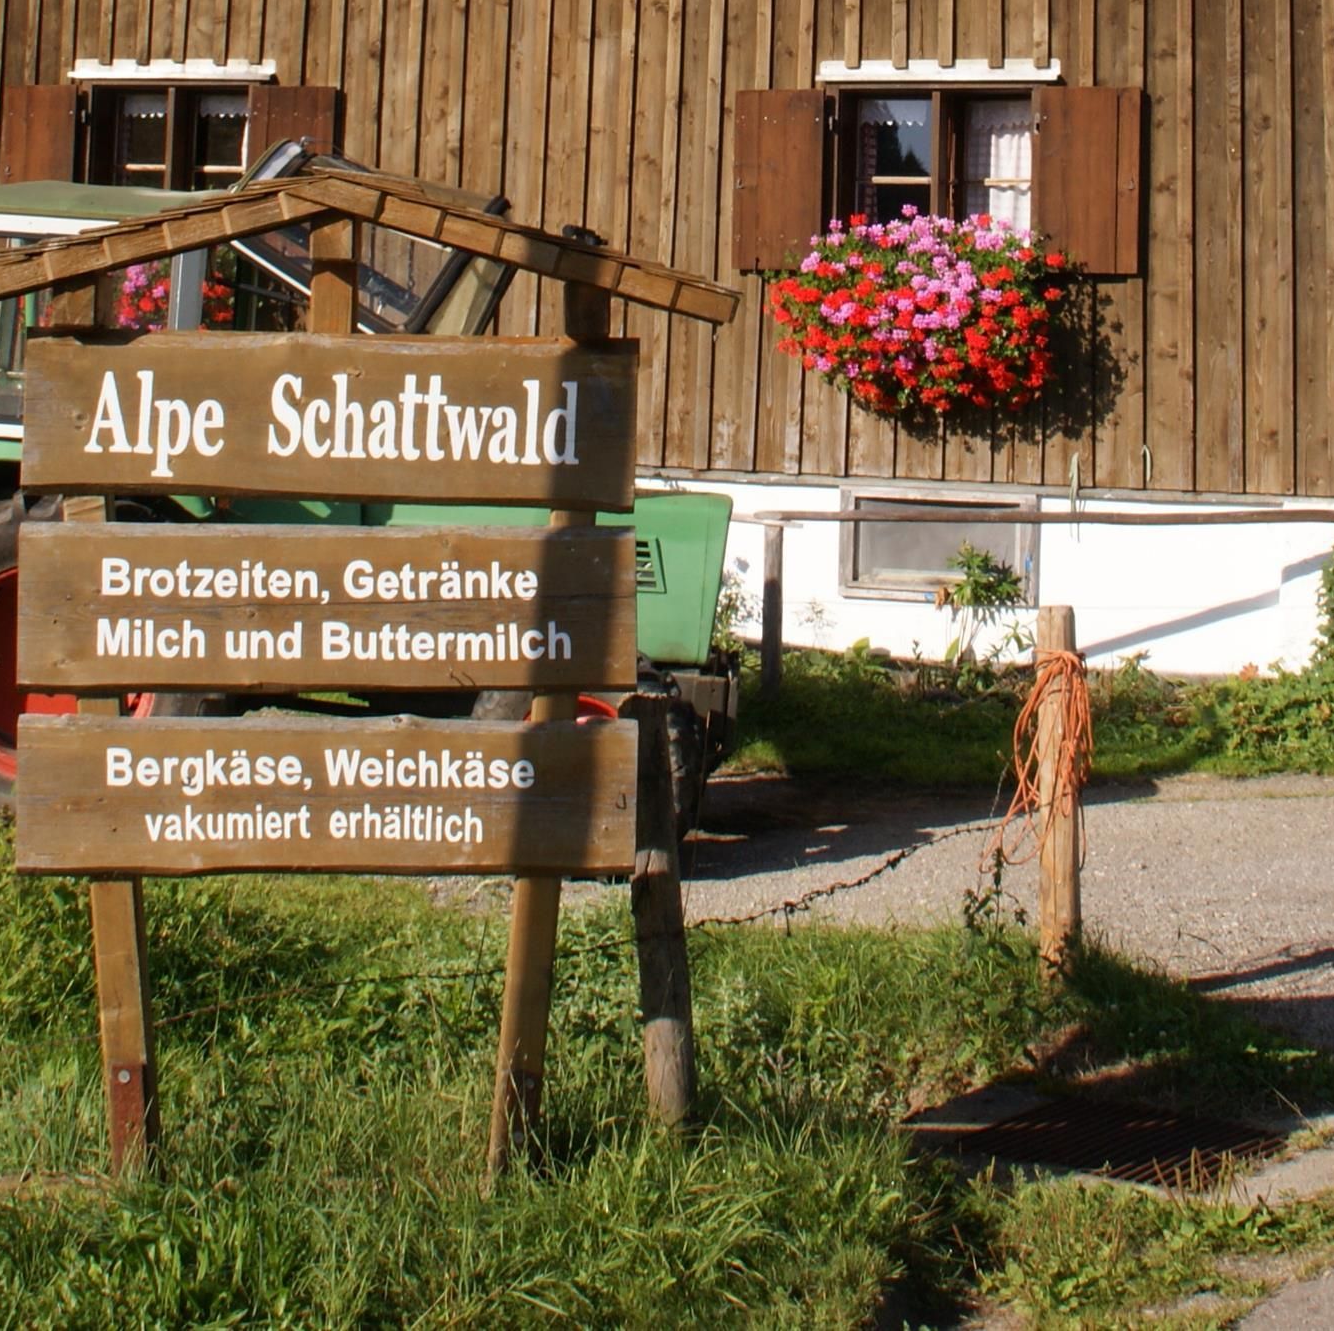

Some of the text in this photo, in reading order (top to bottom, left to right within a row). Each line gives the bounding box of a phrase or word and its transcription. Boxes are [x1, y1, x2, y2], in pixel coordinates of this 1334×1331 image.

[83, 370, 579, 478] Alpe Schattwald
[100, 557, 539, 605] Brotzeiten, Getränke
[95, 618, 572, 662] Milch und Buttermilch
[105, 746, 536, 796] Bergkäse, Weichkäse
[144, 802, 484, 844] vakumiert erhältlich
